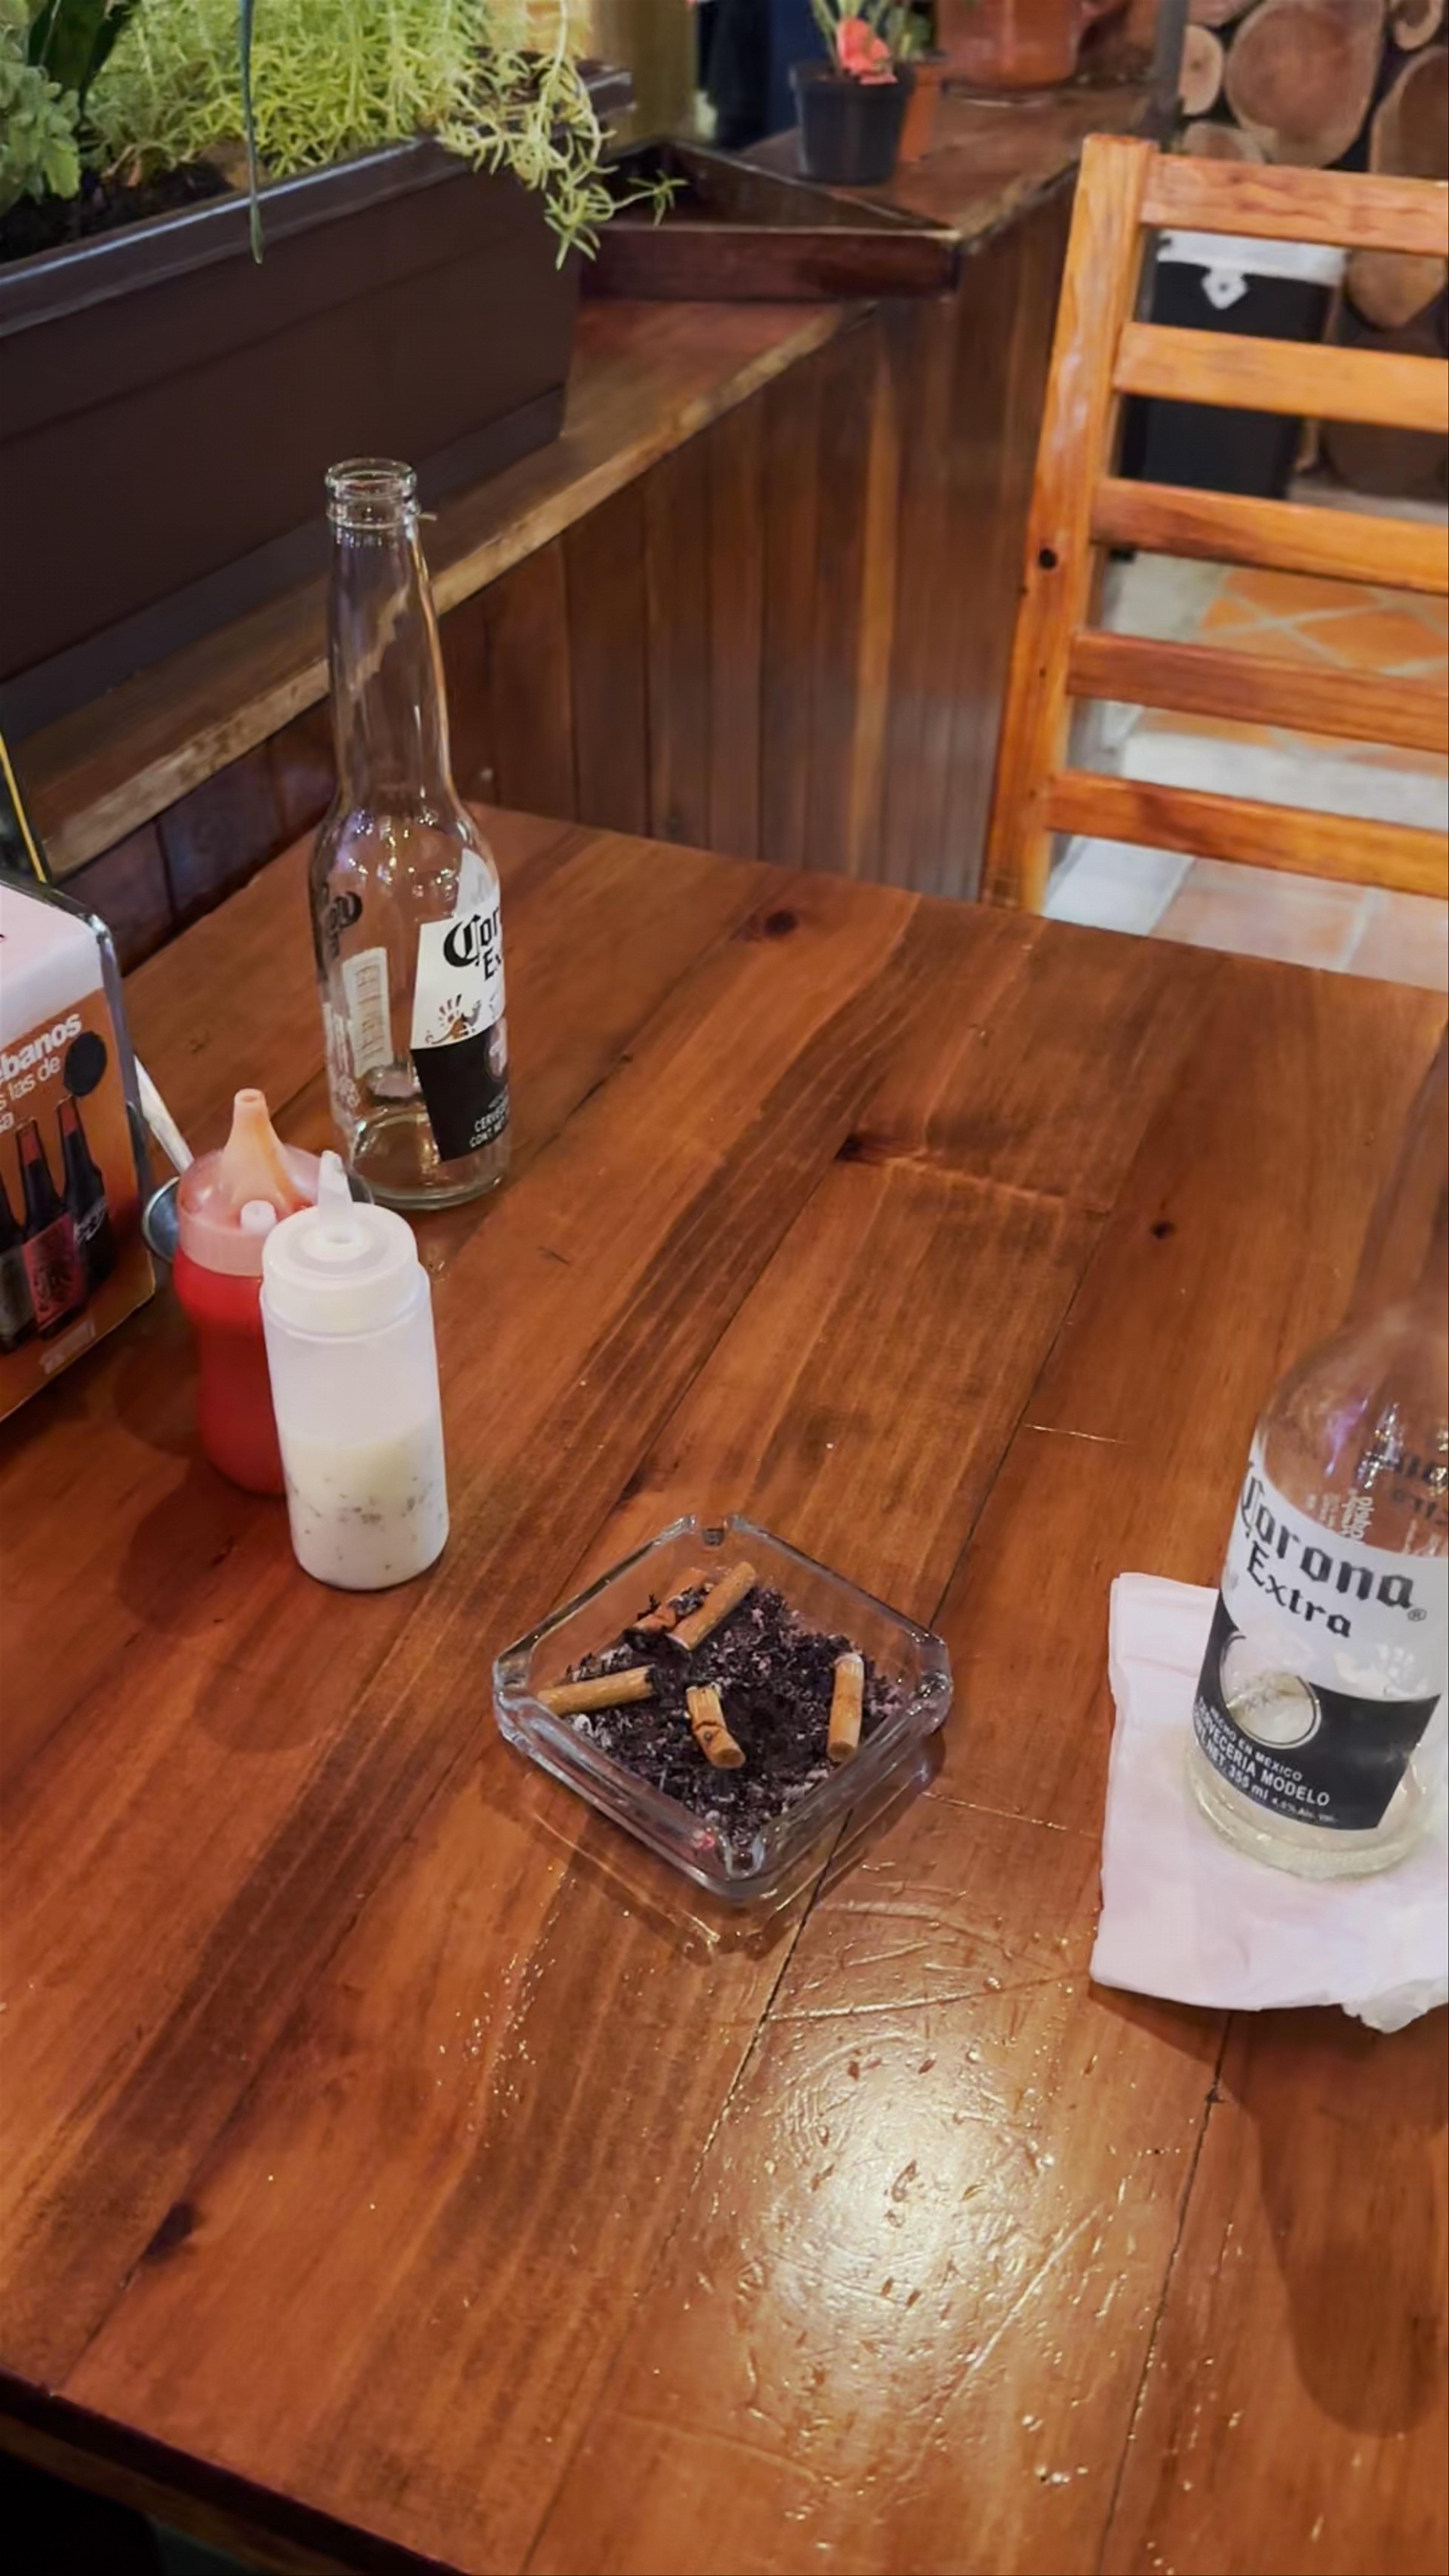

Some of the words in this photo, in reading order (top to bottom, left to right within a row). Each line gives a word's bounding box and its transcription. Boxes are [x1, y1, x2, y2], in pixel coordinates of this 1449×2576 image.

[0, 1013, 82, 1083] banos
[8, 1073, 36, 1101] las
[38, 1057, 62, 1081] de
[1241, 1462, 1414, 1610] Corona
[1247, 1540, 1351, 1638] Extra
[1260, 1769, 1330, 1806] MODELO
